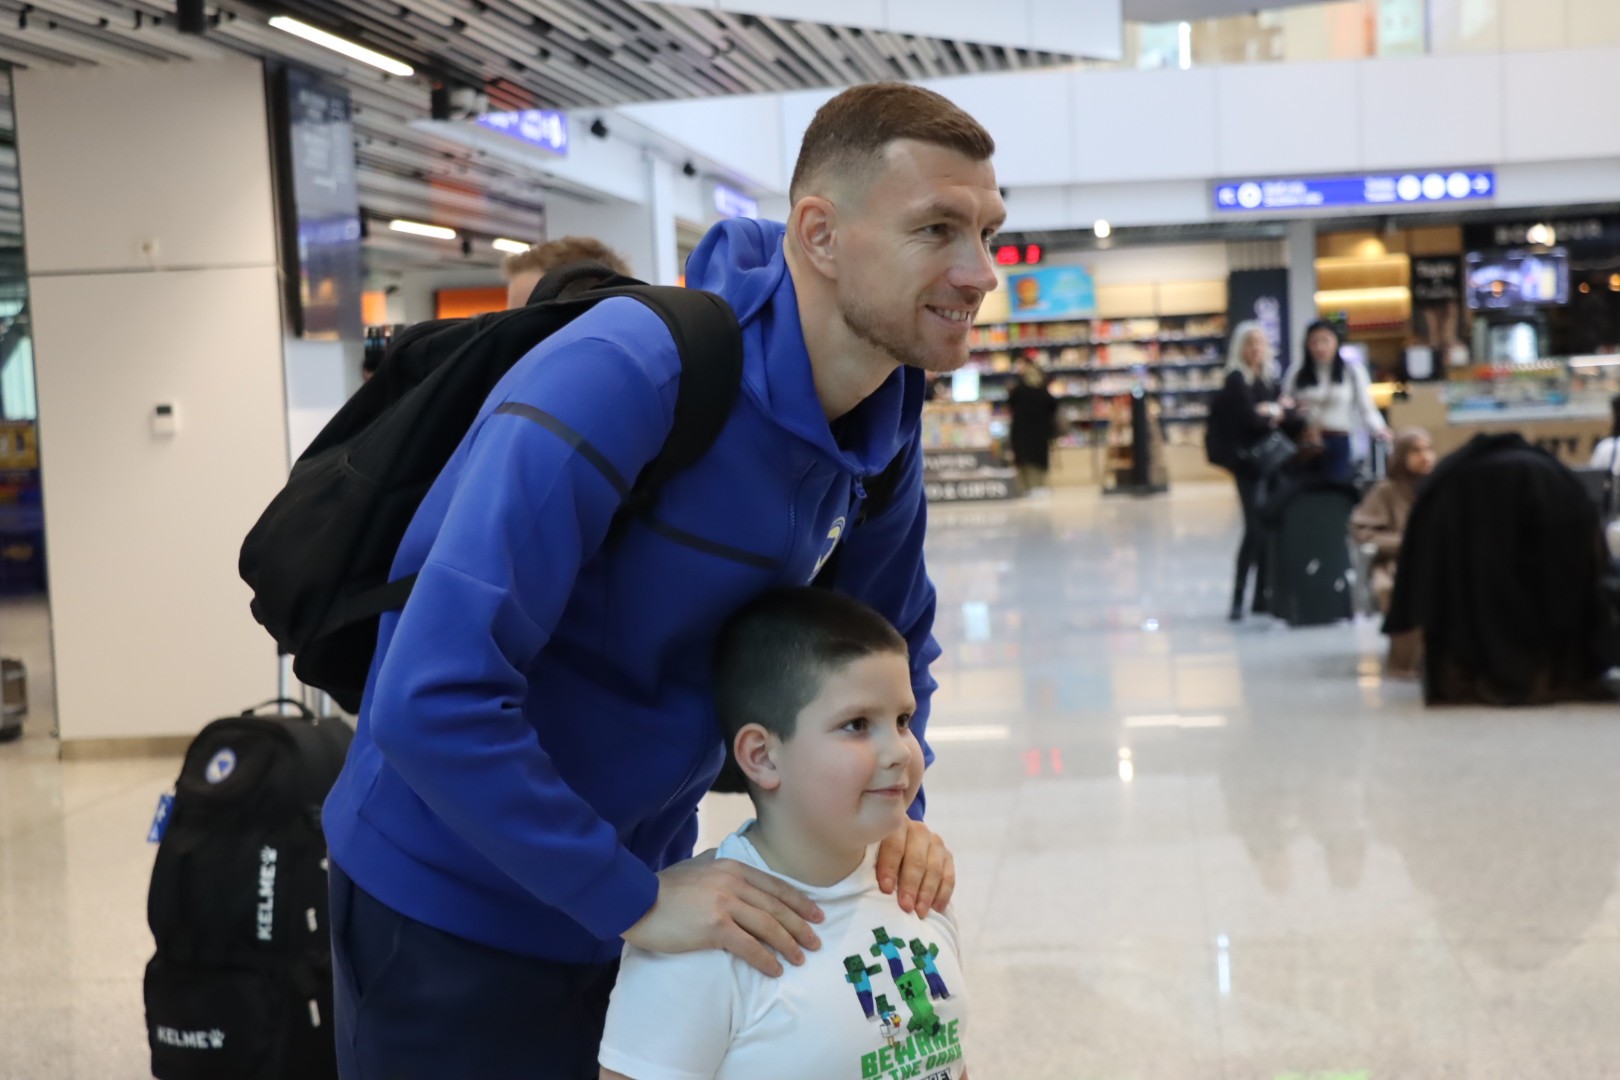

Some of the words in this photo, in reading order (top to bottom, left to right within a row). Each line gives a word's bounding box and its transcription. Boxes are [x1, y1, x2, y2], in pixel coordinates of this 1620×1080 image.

[257, 863, 276, 941] KELME
[157, 1025, 209, 1050] KELME
[861, 1018, 959, 1079] BEWARE
